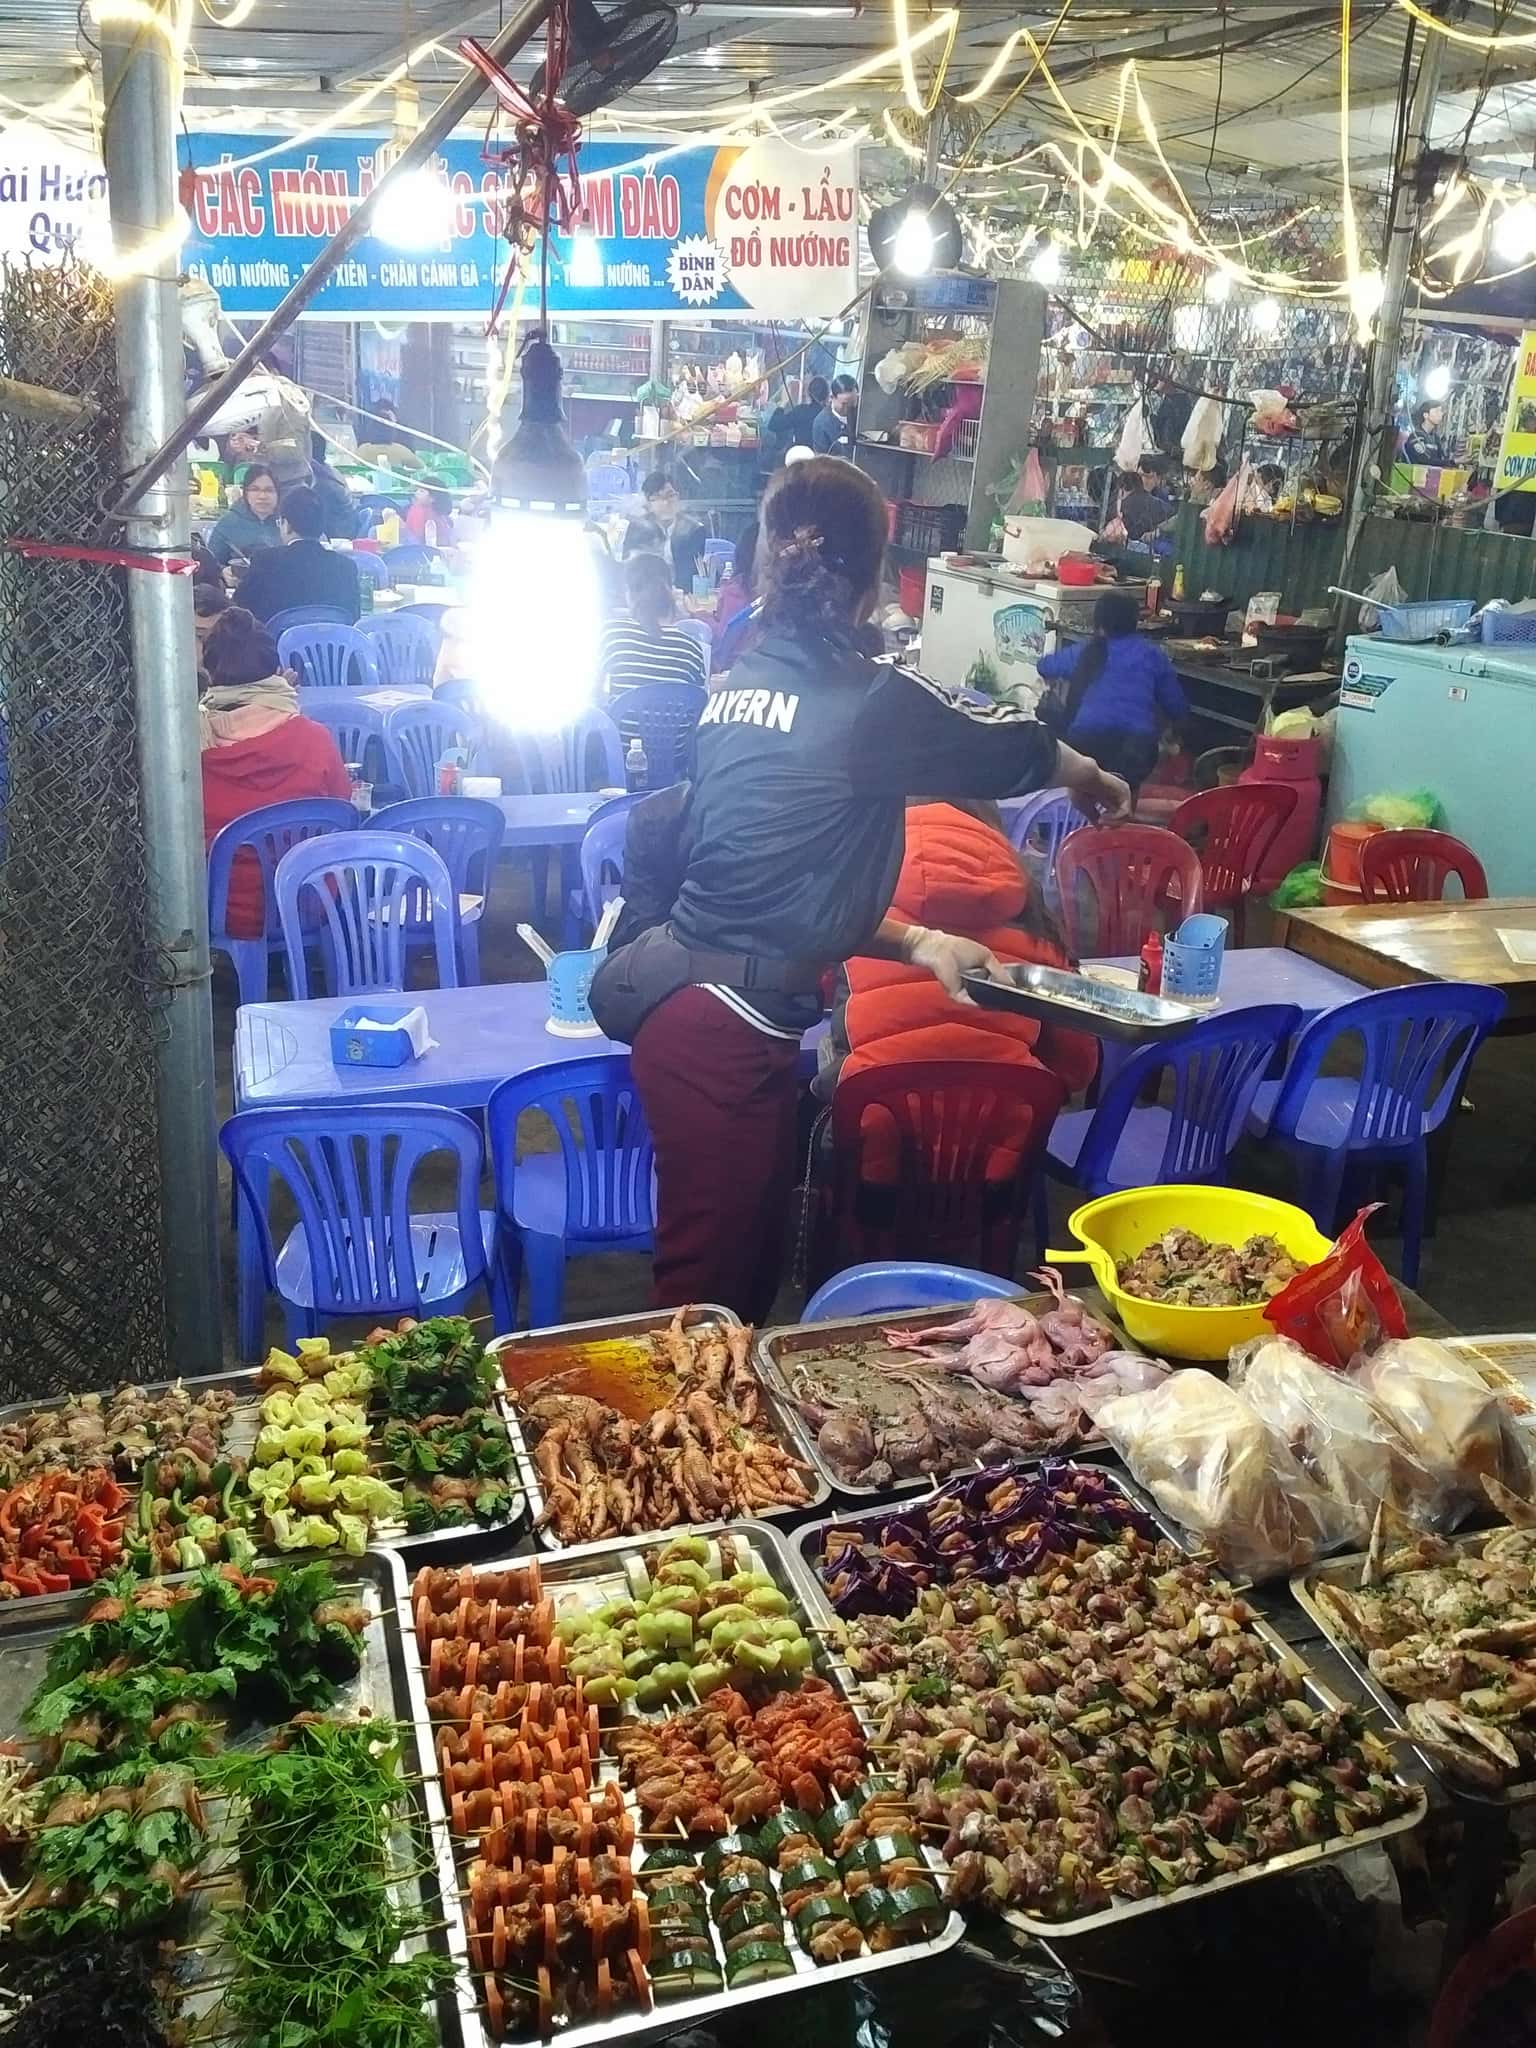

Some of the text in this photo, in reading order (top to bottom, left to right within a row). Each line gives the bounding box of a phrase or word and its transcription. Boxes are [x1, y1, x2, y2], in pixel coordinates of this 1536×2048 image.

[195, 153, 264, 237] CÁC
[270, 155, 349, 237] MÓN
[725, 180, 781, 220] CƠM
[802, 166, 853, 221] LẨU
[679, 253, 715, 271] BÌNH
[731, 226, 850, 267] ĐỒ NƯỚNG
[240, 259, 289, 287] NƯỚNG
[380, 259, 418, 287] CHÂN
[421, 259, 457, 287] CÁNH
[460, 260, 479, 287] GÀ
[607, 260, 650, 286] NƯỚNG
[682, 273, 714, 290] DÂN
[698, 689, 799, 733] AYERN
